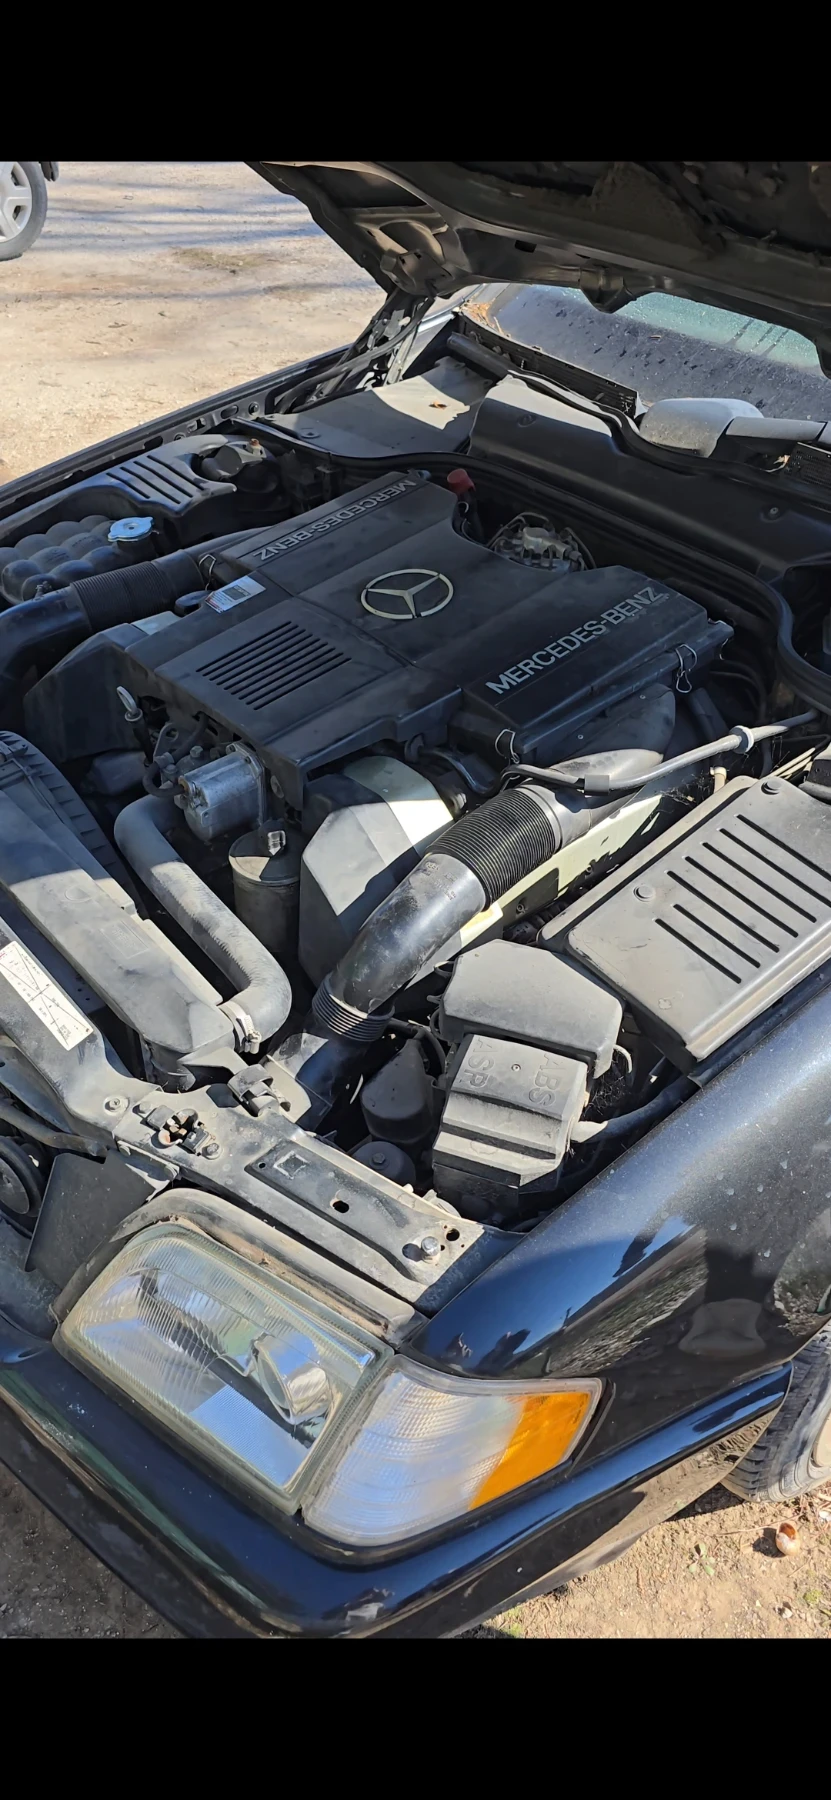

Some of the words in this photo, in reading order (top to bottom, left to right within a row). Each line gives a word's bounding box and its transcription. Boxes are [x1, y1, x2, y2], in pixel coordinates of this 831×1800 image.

[253, 480, 417, 561] MERCEDES-BENZ
[485, 586, 665, 695] MERCEDES-BENZ
[528, 1053, 568, 1106] ABS
